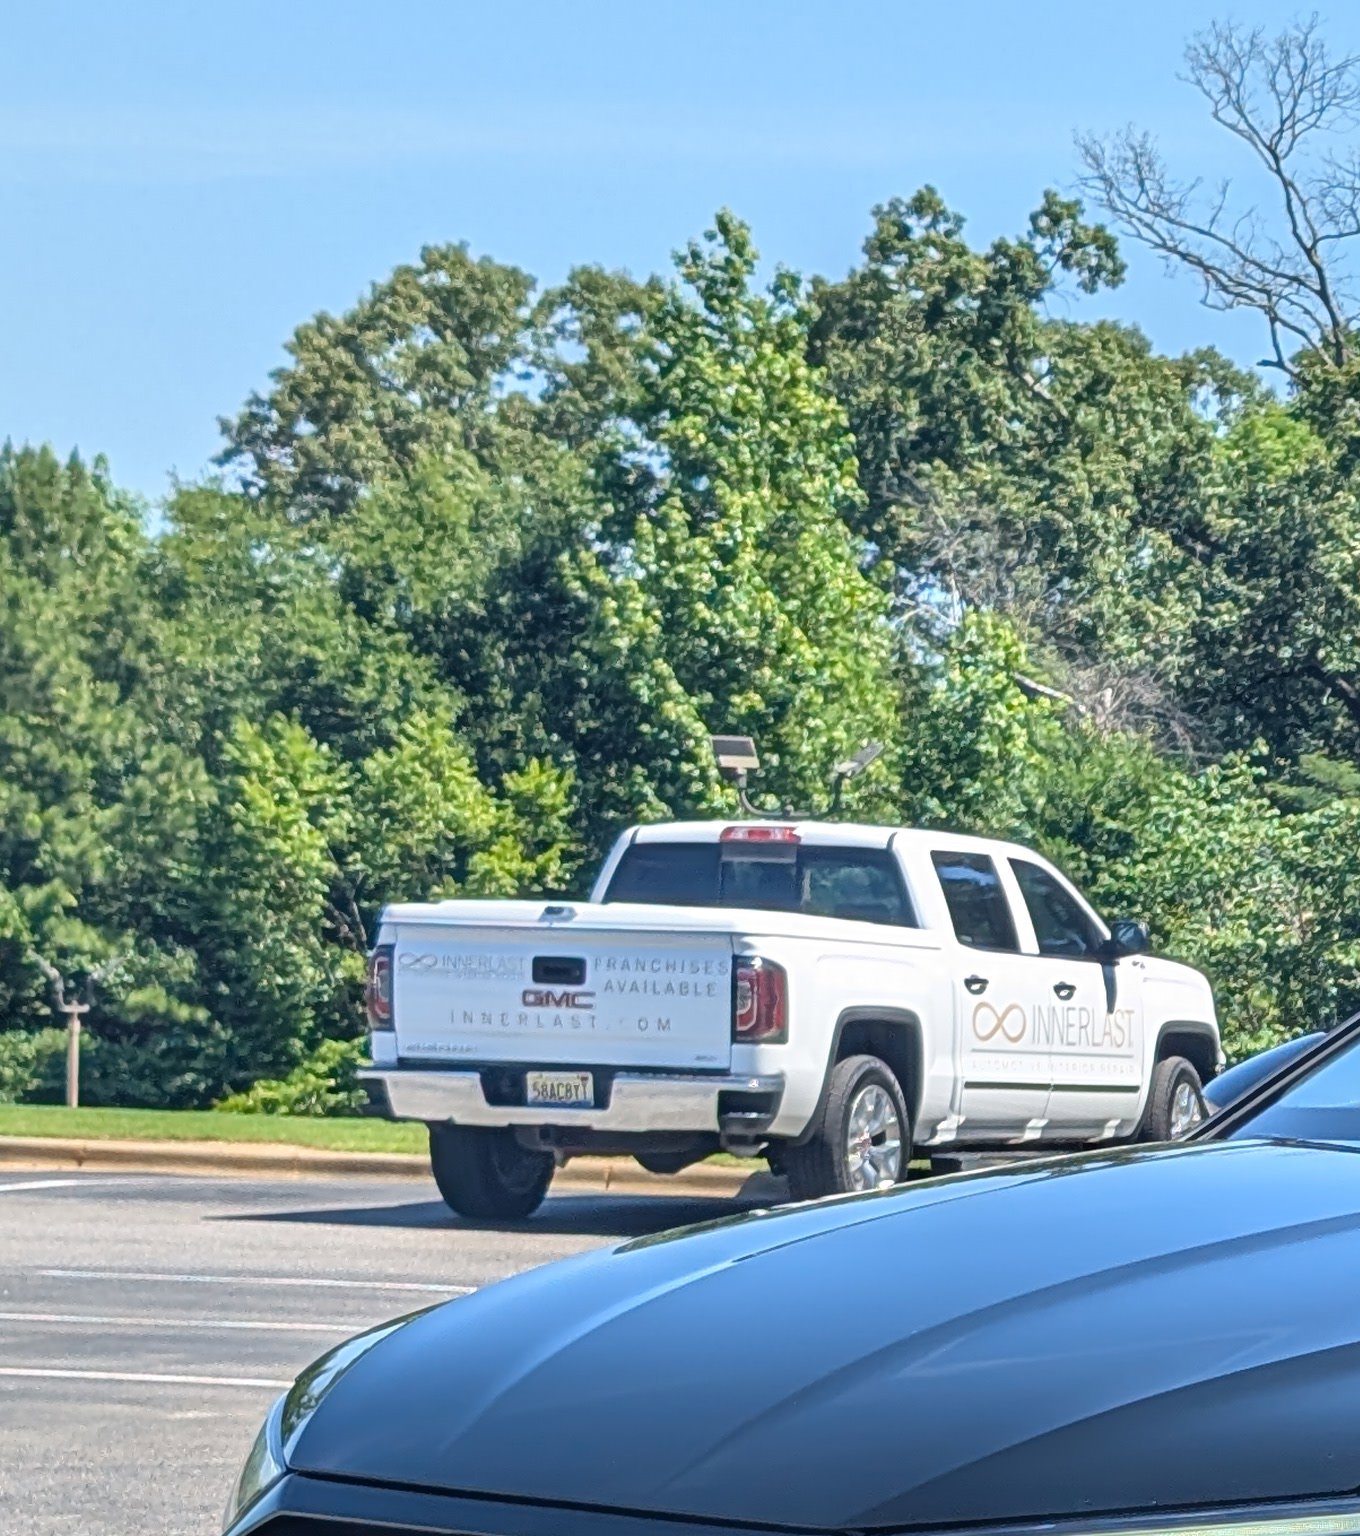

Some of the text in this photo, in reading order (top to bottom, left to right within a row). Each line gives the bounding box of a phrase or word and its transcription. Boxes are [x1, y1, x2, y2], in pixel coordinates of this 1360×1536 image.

[604, 979, 717, 997] AVAILABLE
[522, 989, 597, 1009] GMC
[1031, 1003, 1135, 1048] INNERLAST
